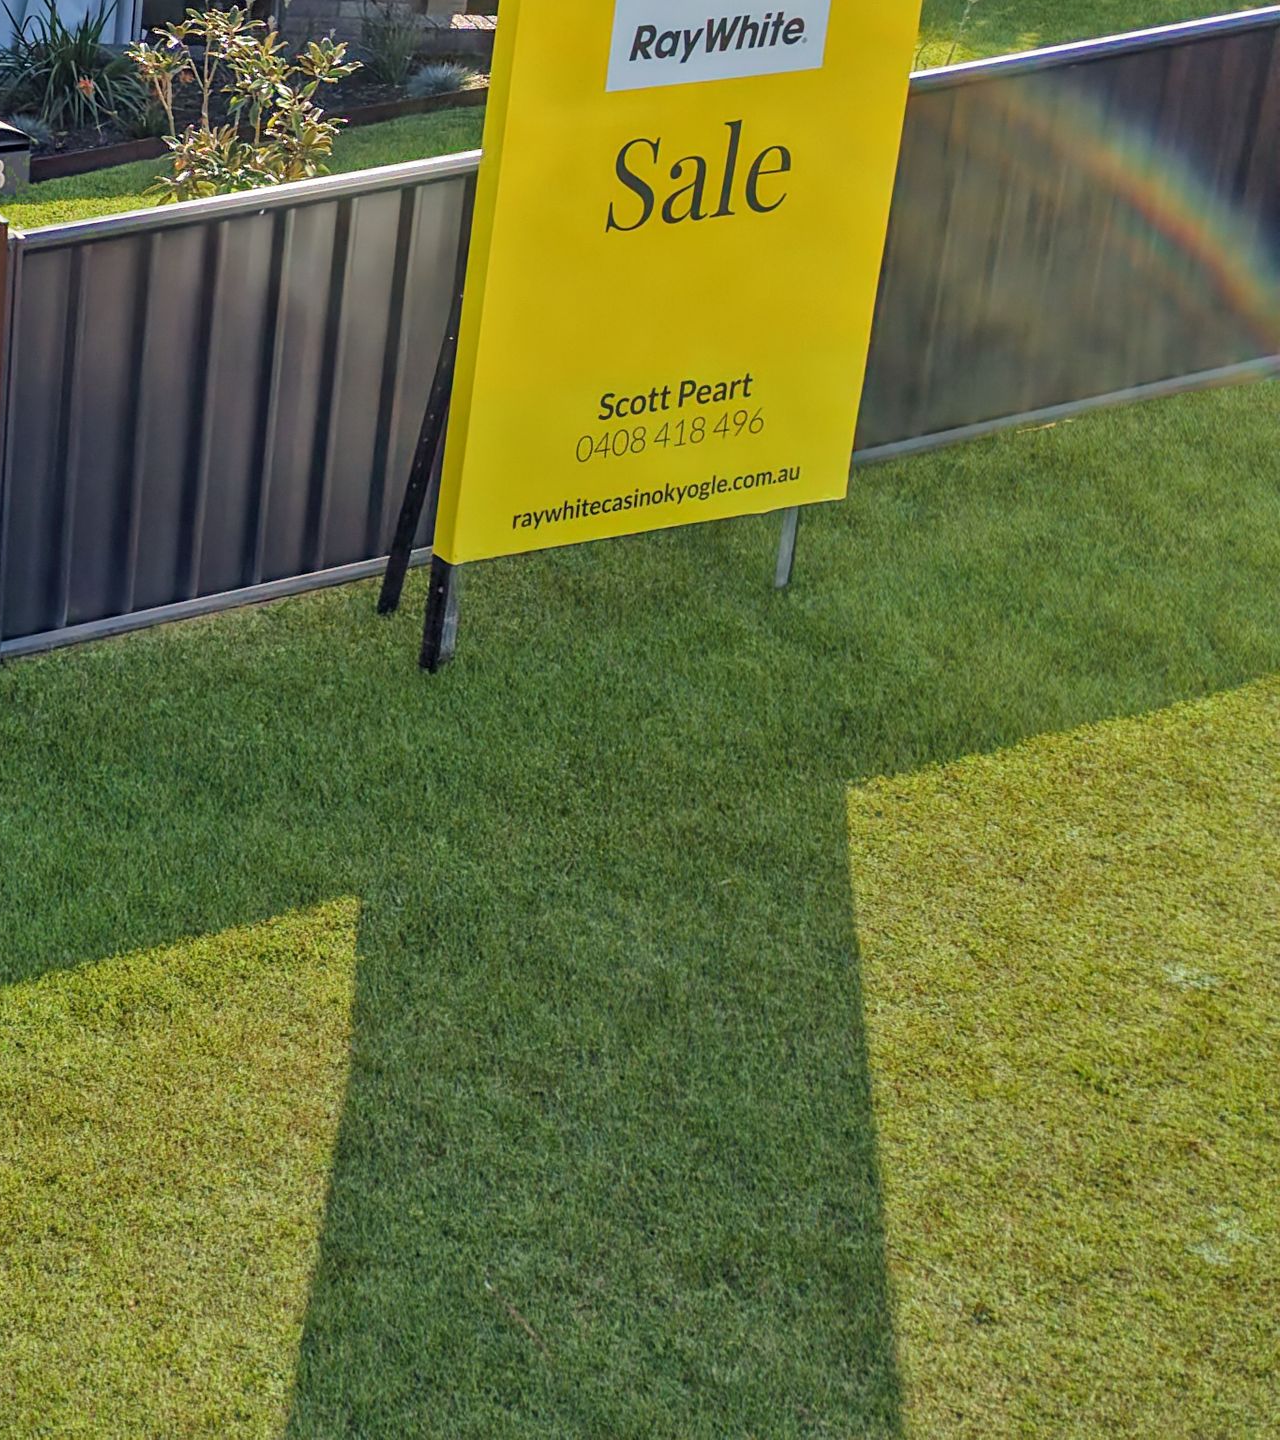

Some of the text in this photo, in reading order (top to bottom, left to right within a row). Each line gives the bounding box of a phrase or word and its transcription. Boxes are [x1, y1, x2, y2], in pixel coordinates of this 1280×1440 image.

[605, 119, 792, 233] Sale
[598, 372, 753, 420] Scott Peart
[576, 407, 765, 462] 0408 418 496
[512, 465, 801, 530] raywhitecasinokyogle.com.au
